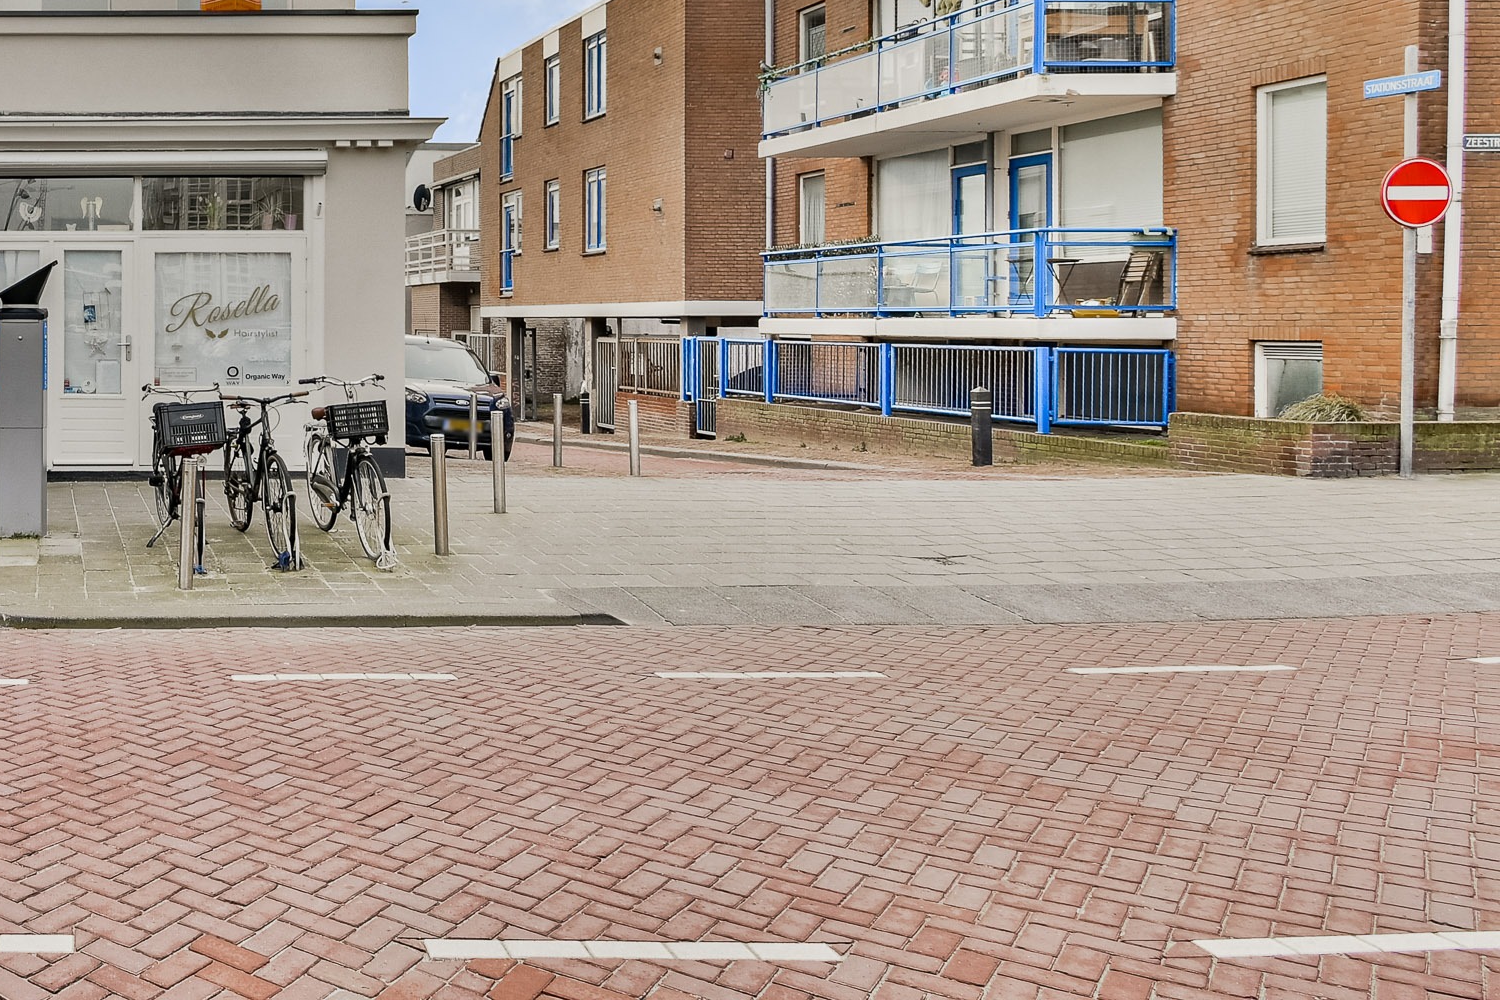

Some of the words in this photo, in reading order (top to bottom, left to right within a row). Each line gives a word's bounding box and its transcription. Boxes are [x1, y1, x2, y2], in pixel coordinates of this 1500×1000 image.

[1365, 75, 1434, 95] STATIONSSTRAAT
[165, 284, 280, 333] Rosella
[233, 328, 279, 339] Hairstylist
[245, 373, 271, 381] Organic
[271, 373, 286, 381] Way
